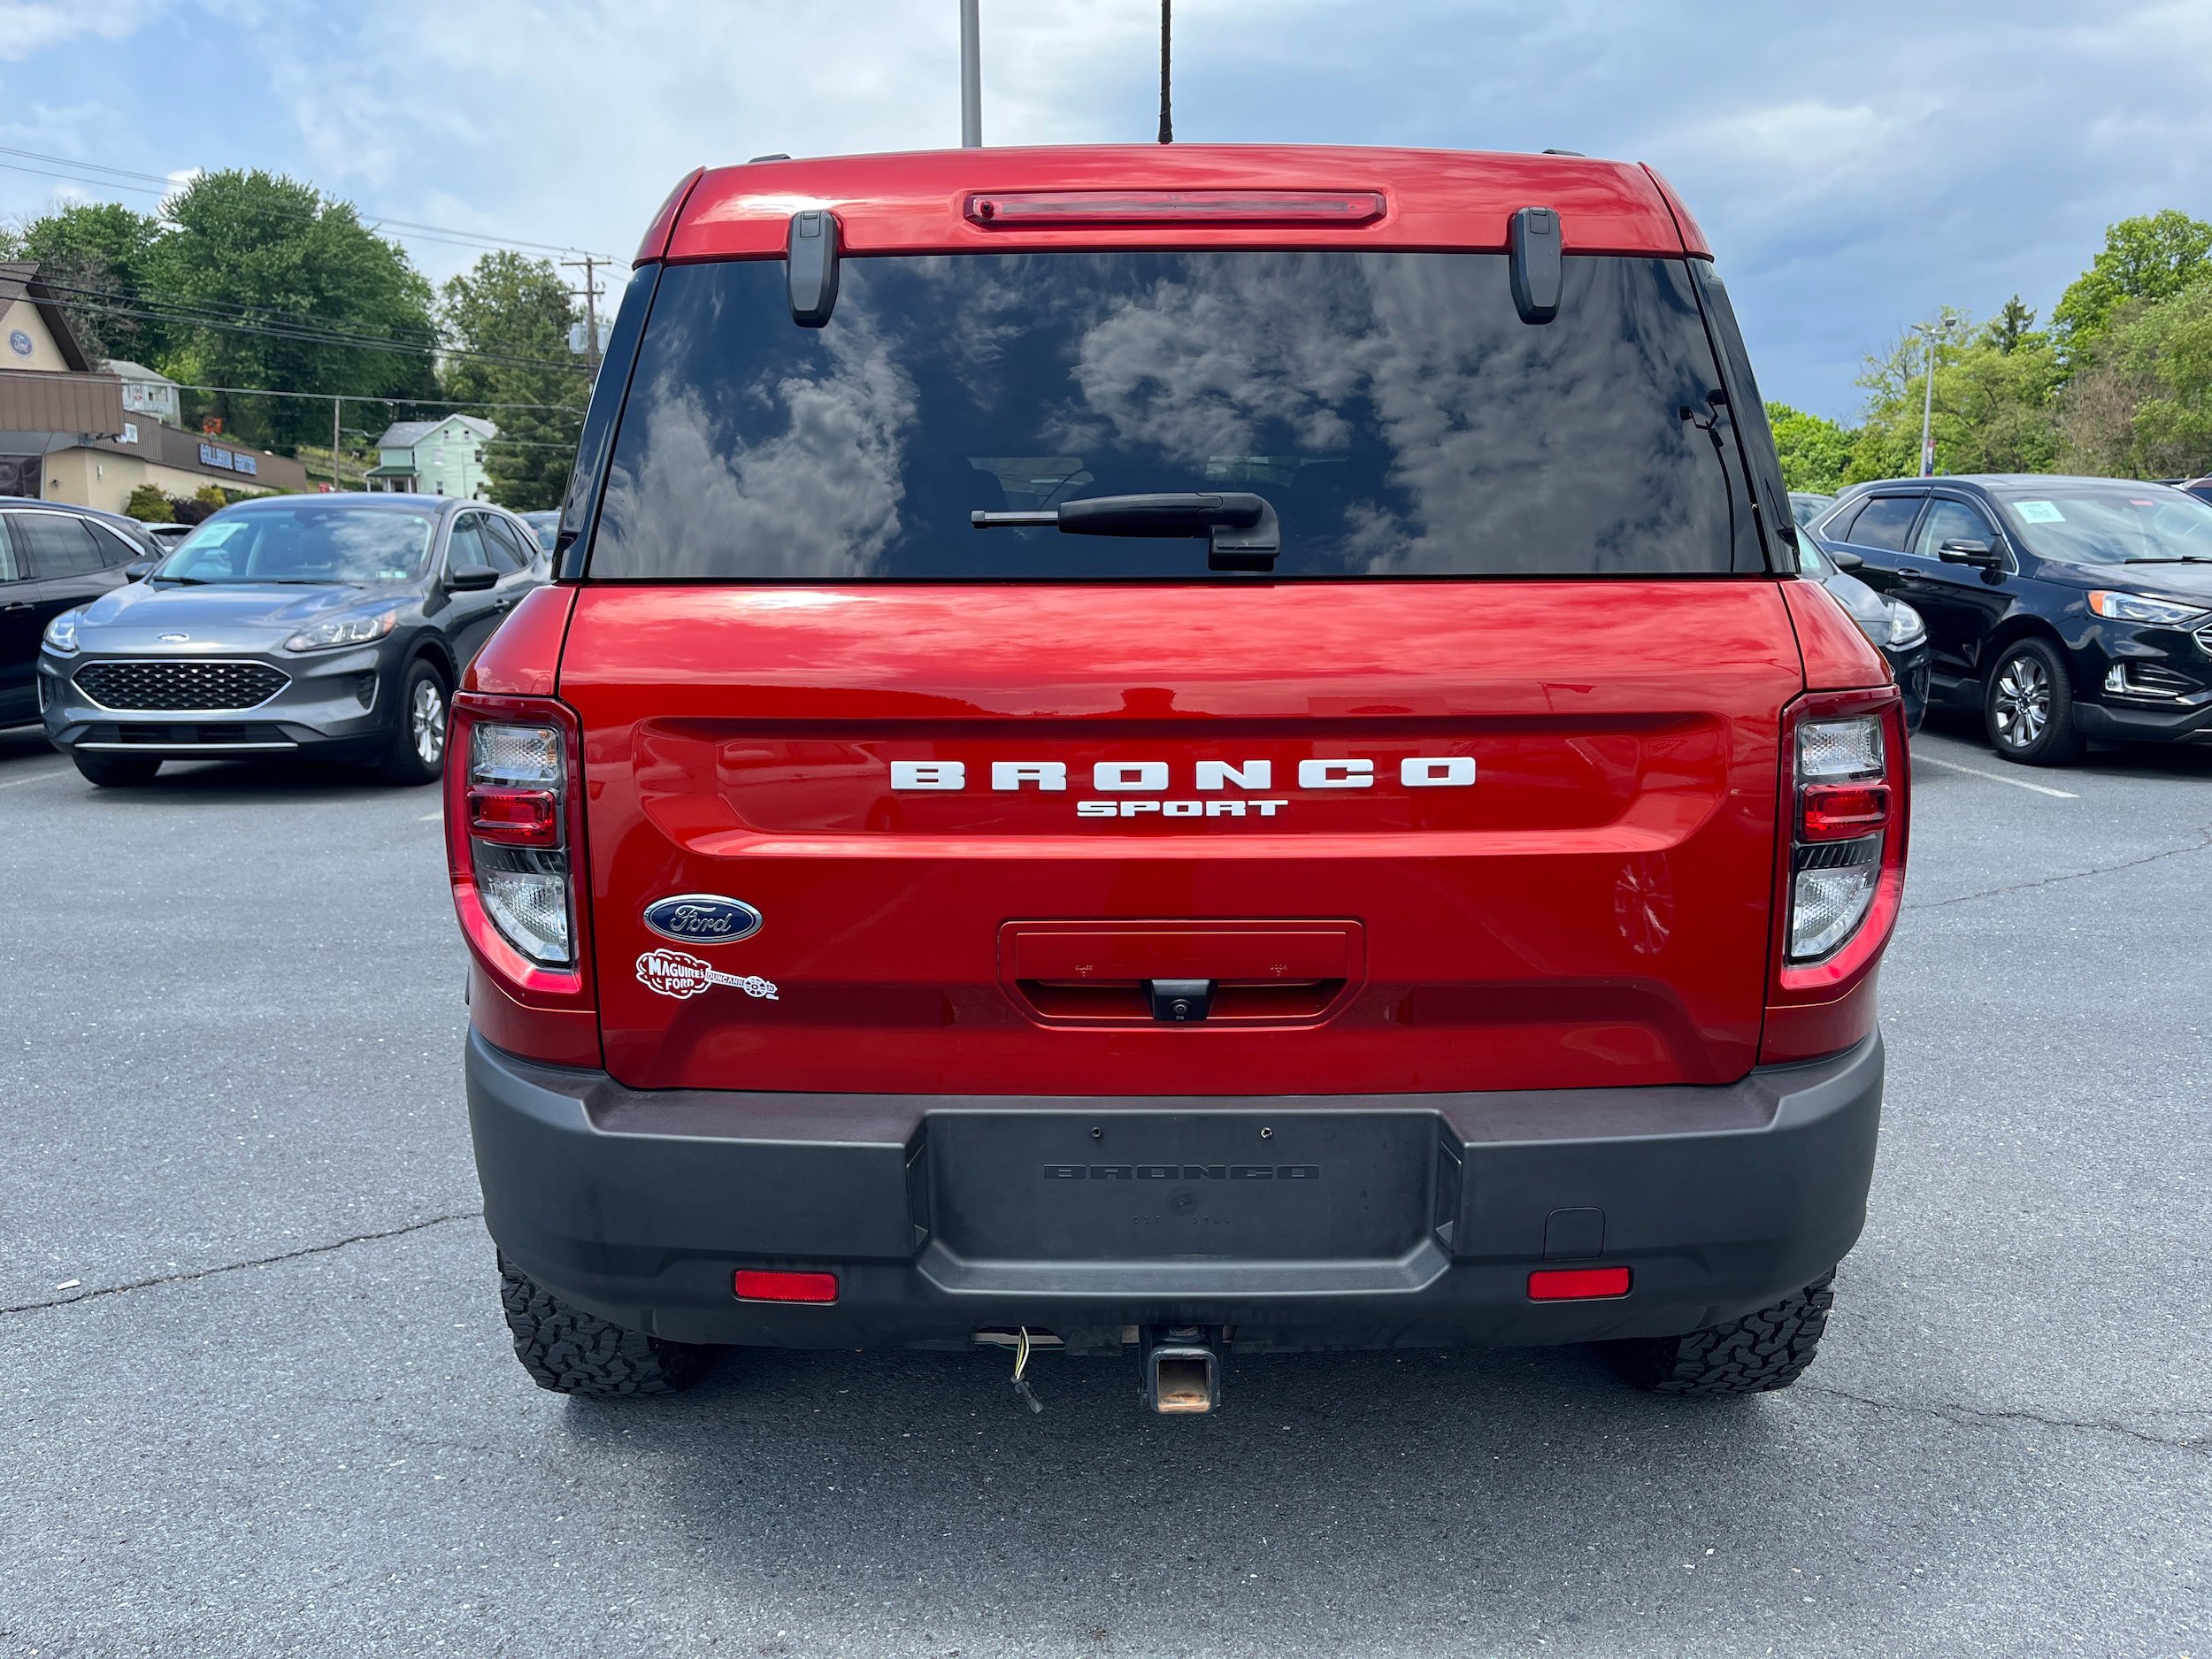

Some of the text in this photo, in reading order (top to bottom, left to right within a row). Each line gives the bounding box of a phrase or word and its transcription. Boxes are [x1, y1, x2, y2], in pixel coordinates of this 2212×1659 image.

[890, 757, 1476, 791] BRONCO
[1076, 799, 1289, 818] SPORT
[670, 904, 733, 932] Ford
[664, 977, 695, 991] FORD
[1043, 1164, 1320, 1180] BRONCO
